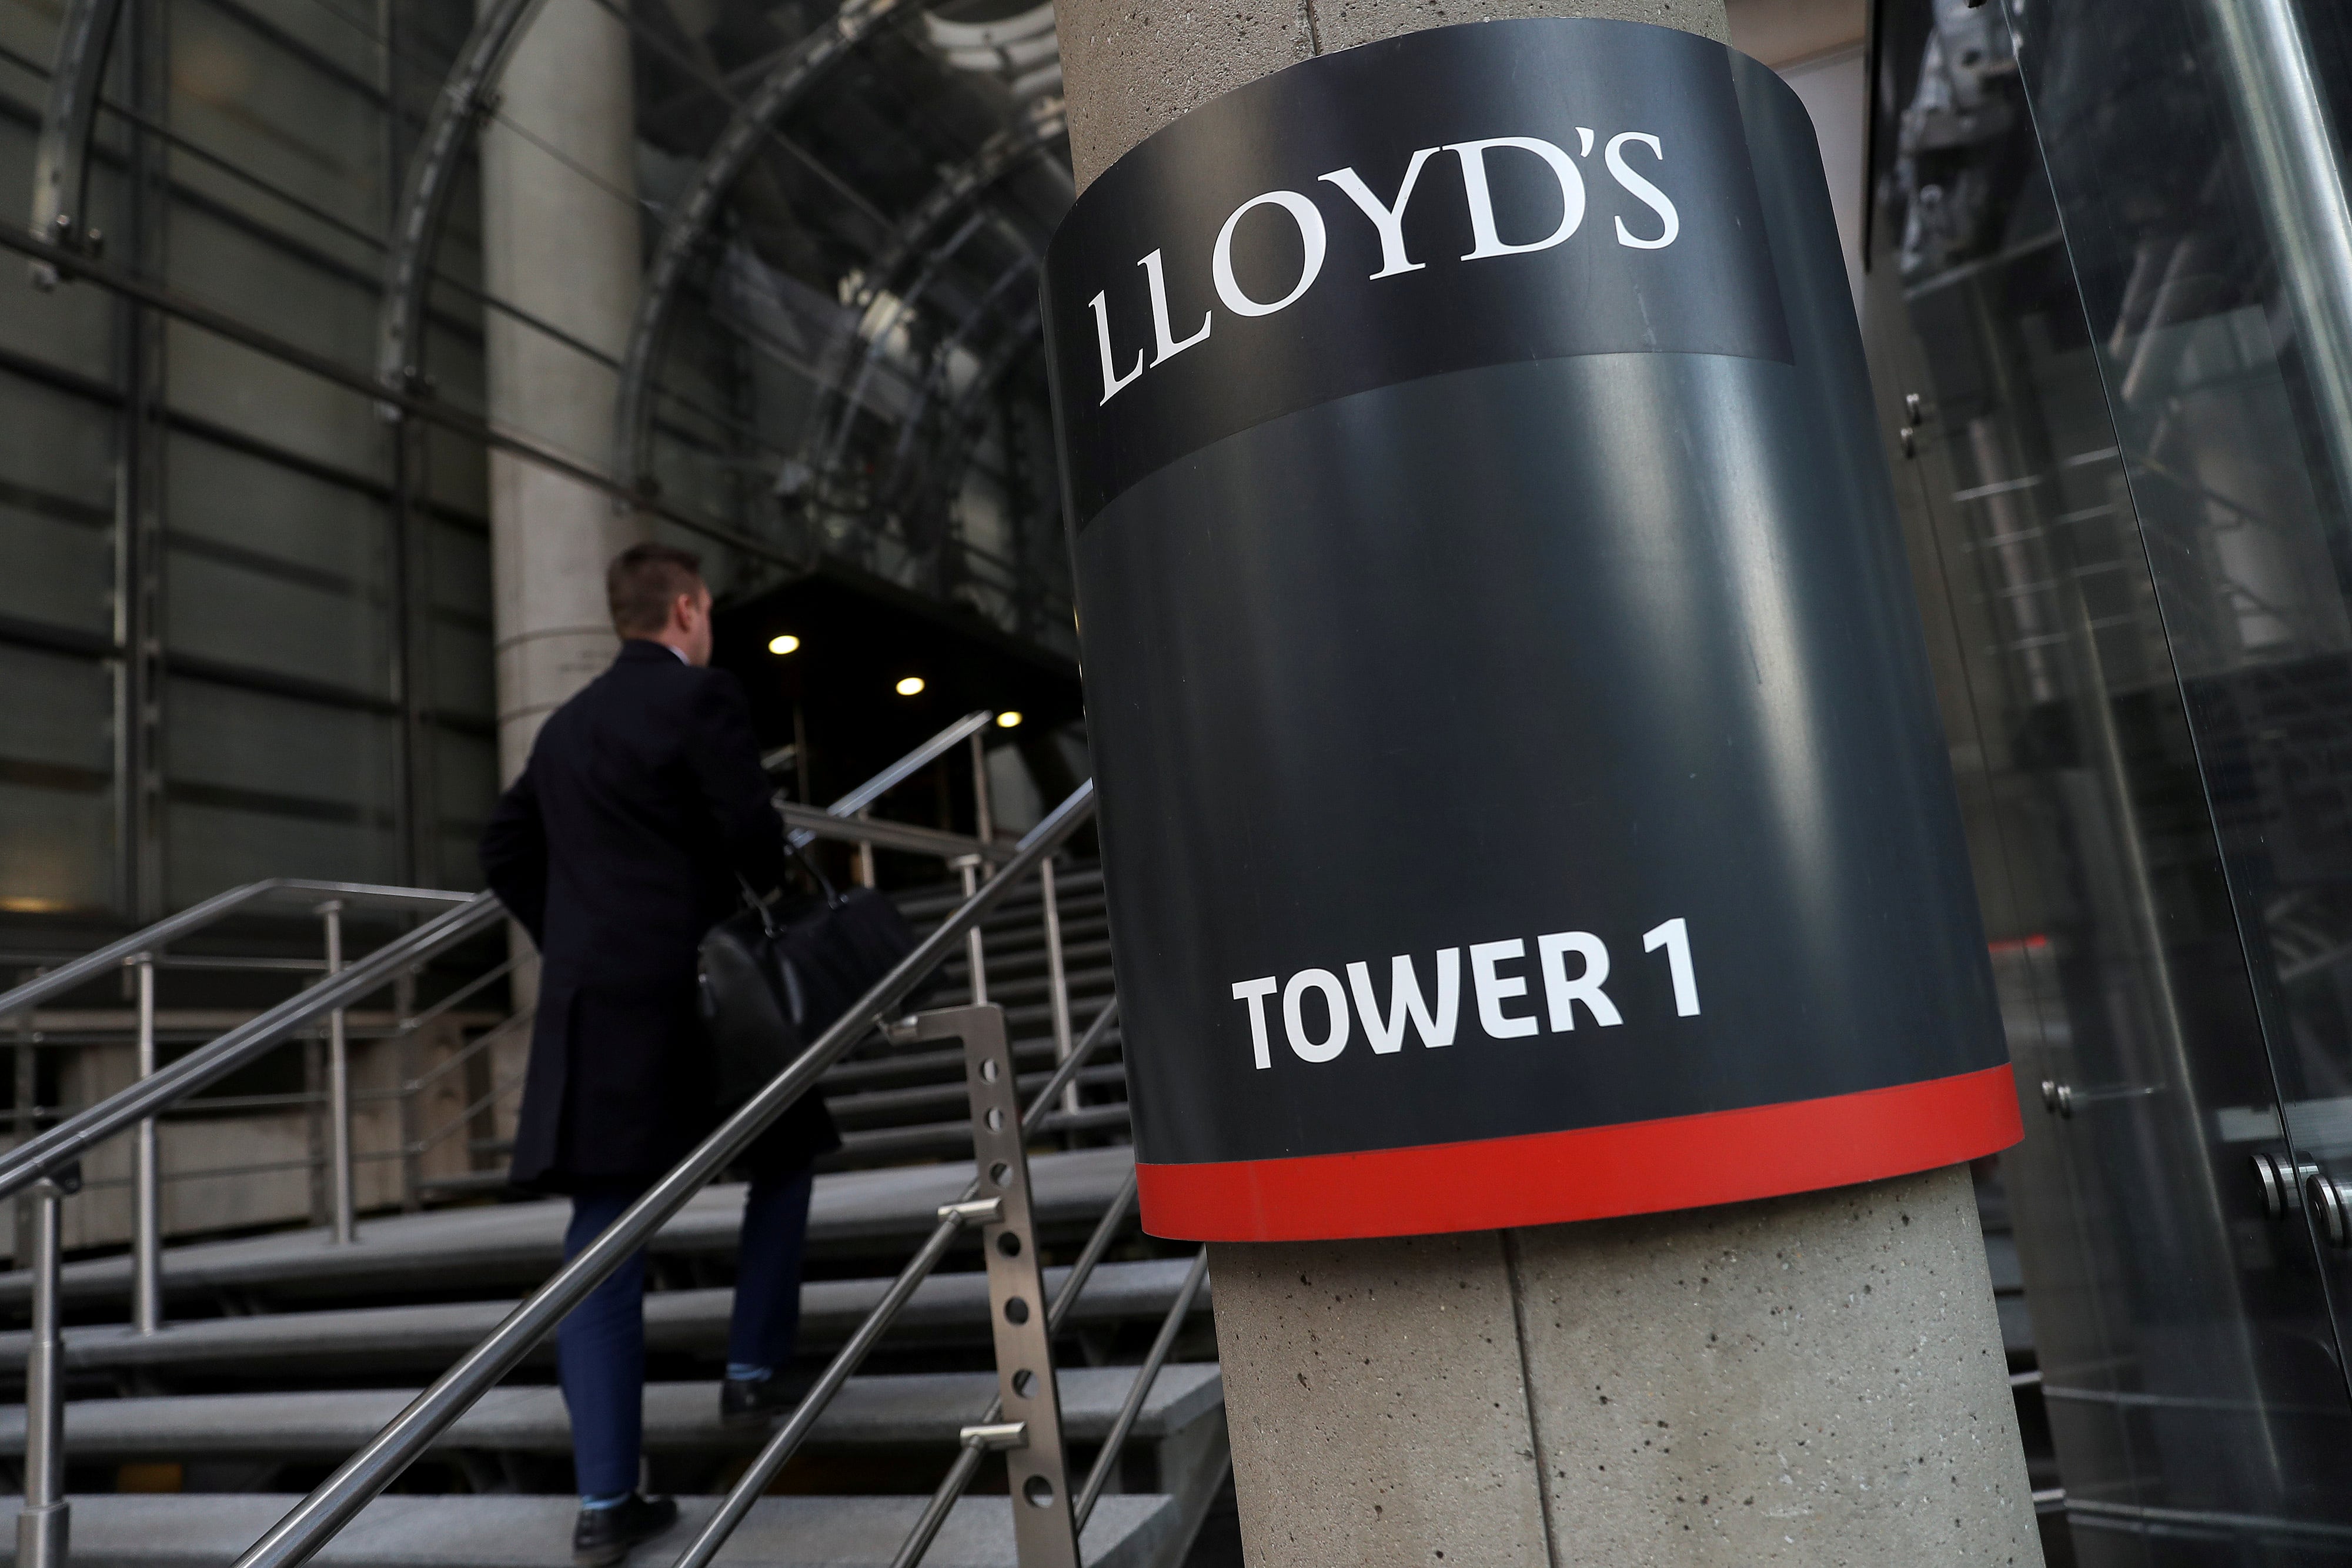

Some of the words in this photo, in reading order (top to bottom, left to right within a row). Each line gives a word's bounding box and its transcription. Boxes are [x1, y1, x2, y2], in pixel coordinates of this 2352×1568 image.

[1088, 126, 1680, 407] LLOYD'S
[1231, 931, 1623, 1069] TOWER
[1642, 918, 1701, 1017] 1
